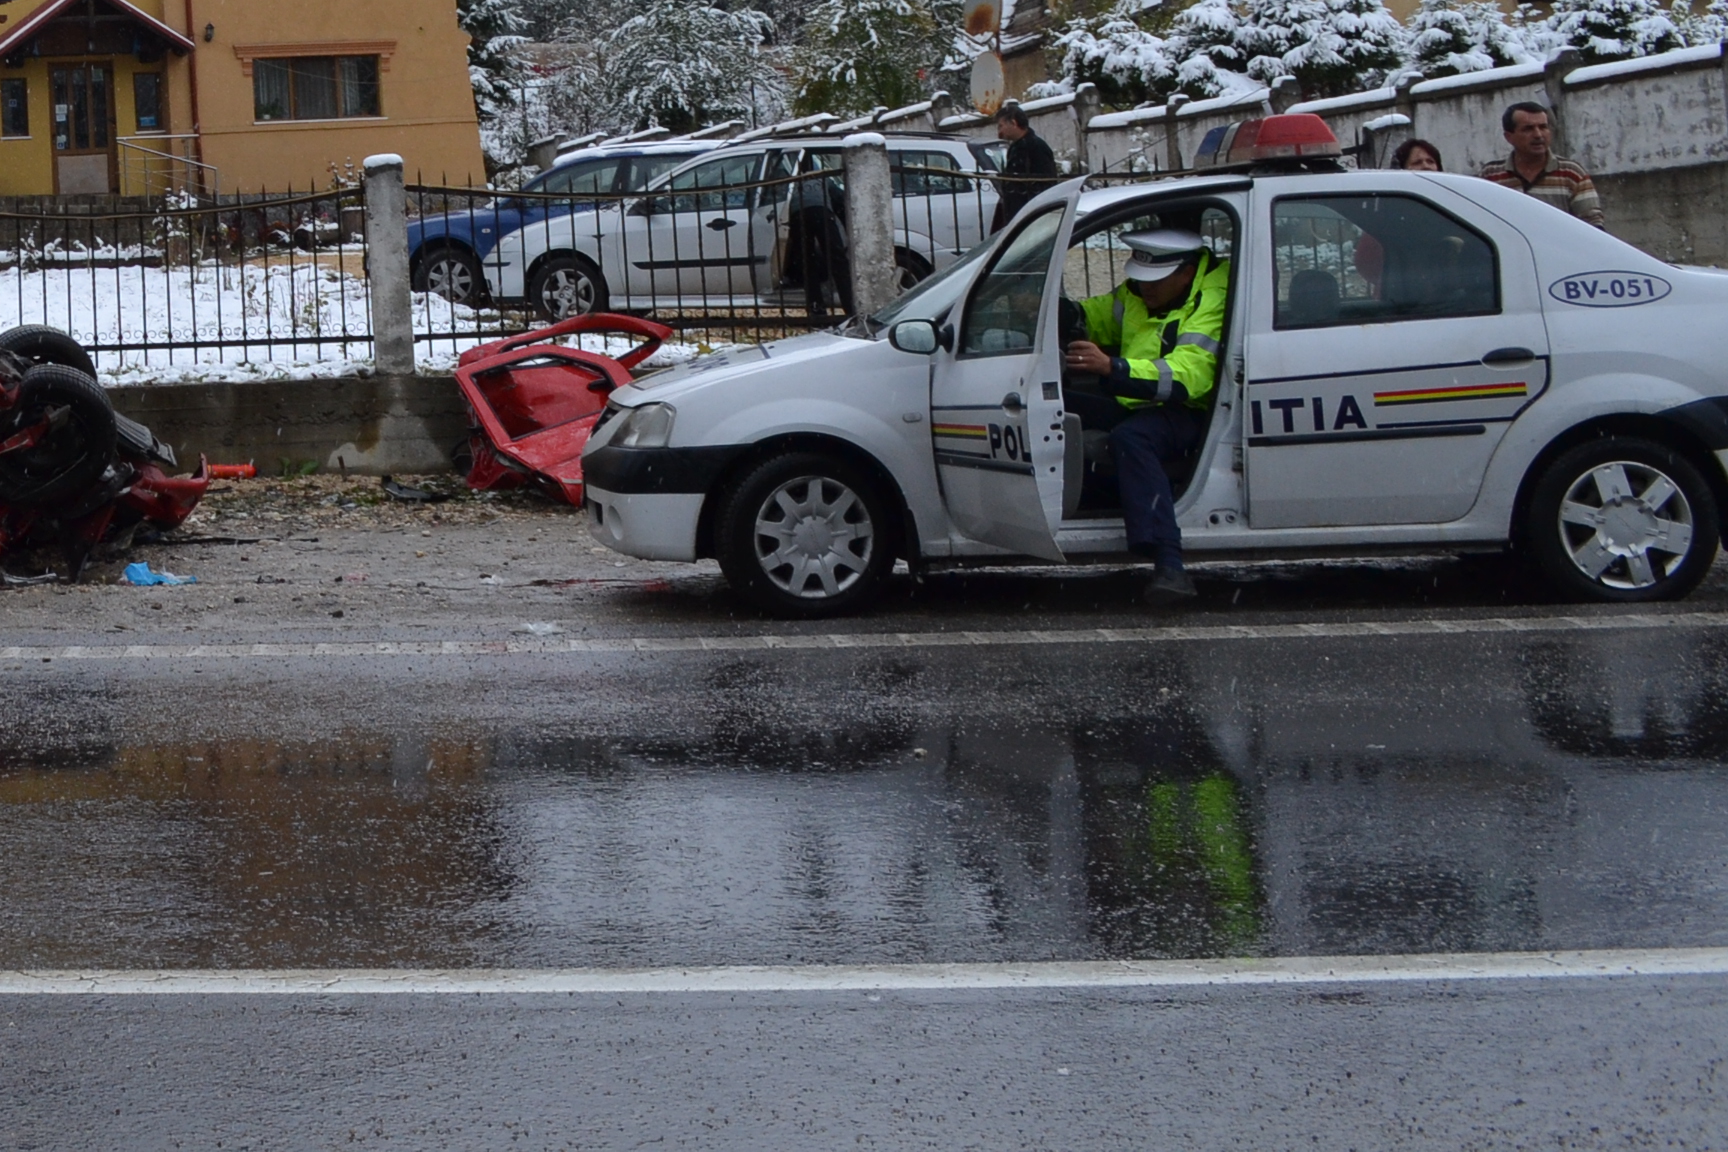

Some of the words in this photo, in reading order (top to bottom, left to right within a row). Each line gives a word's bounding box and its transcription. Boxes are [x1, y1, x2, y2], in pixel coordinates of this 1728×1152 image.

[1564, 278, 1655, 299] BV-051
[1250, 394, 1368, 435] ITIA
[987, 422, 1032, 463] POL
